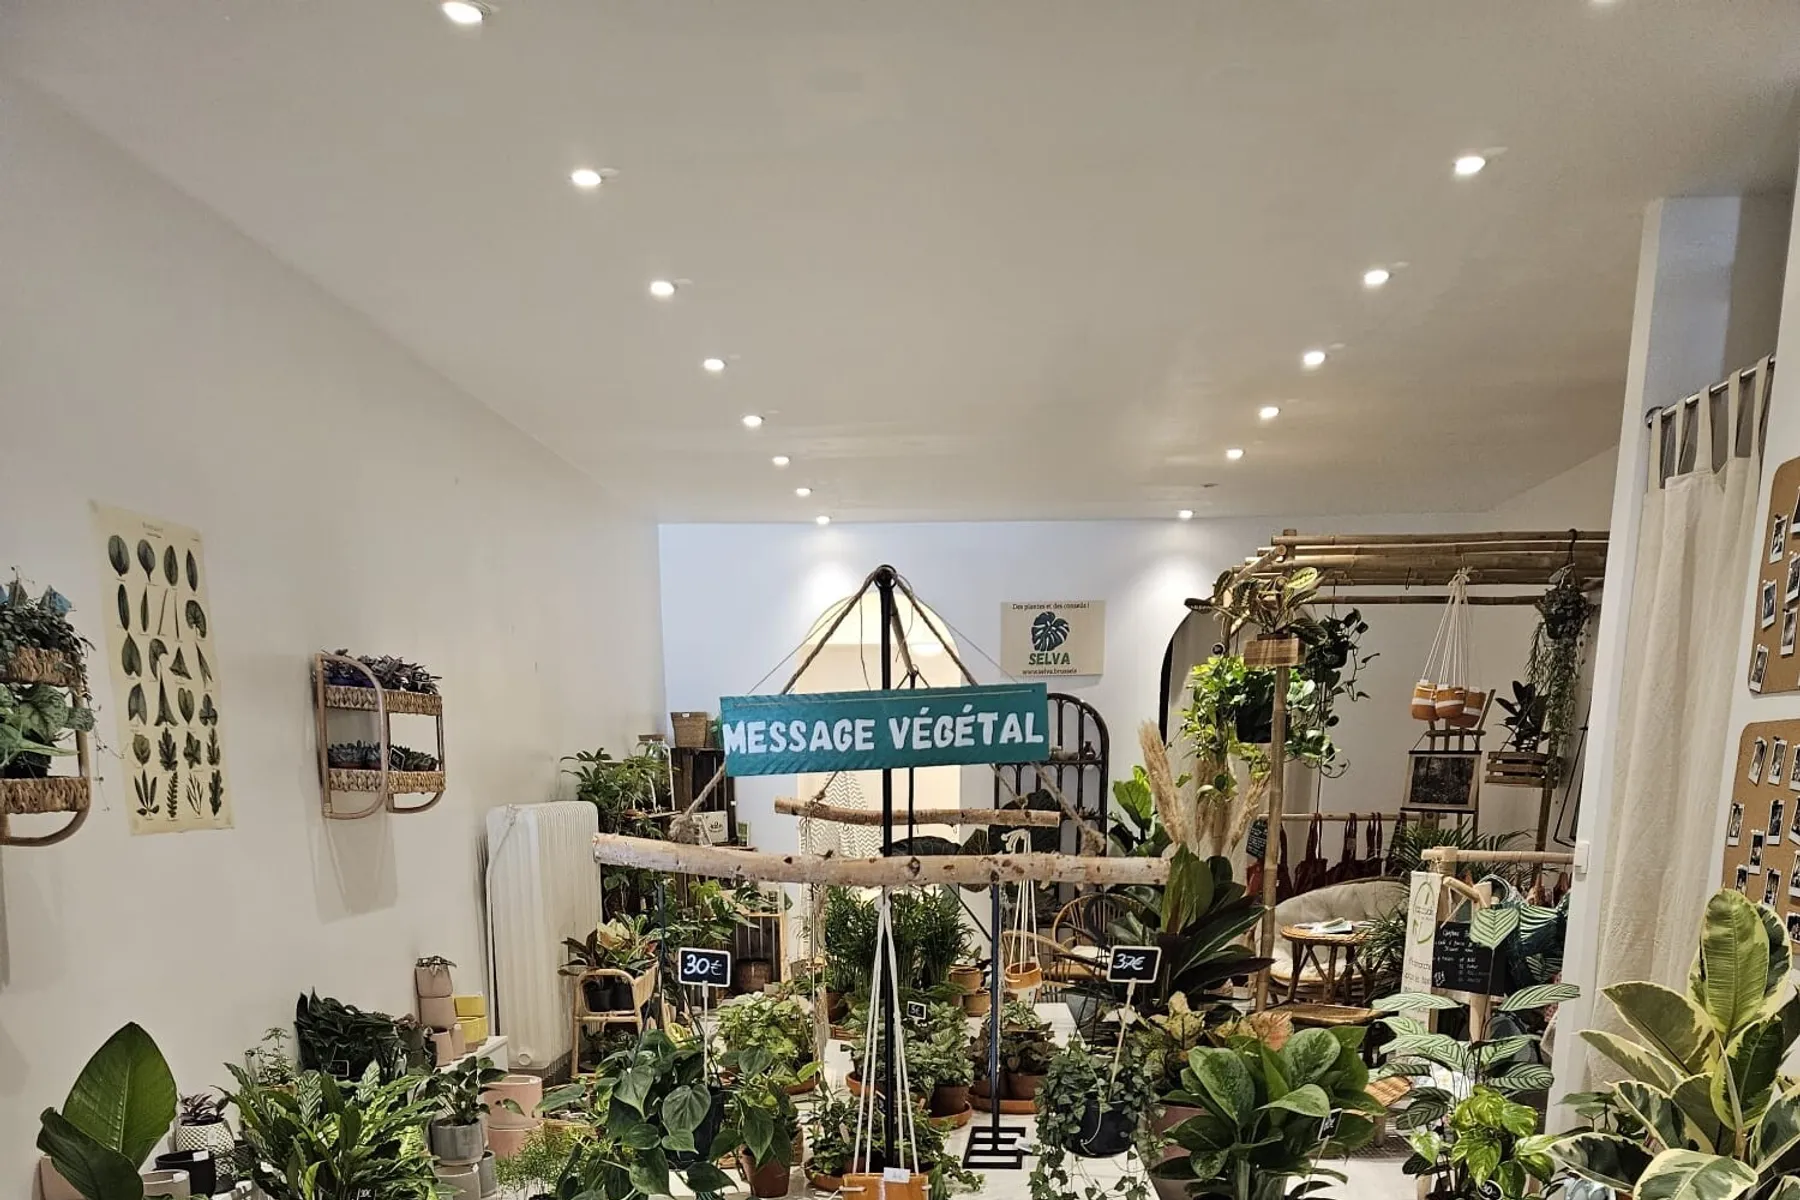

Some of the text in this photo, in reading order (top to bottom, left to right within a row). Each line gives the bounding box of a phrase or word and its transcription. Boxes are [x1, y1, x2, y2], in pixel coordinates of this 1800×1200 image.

[1028, 652, 1071, 665] SELVA
[722, 704, 1044, 756] MESSAGE VÉGÉTAL
[684, 953, 722, 976] 30€
[1113, 953, 1146, 970] 37€
